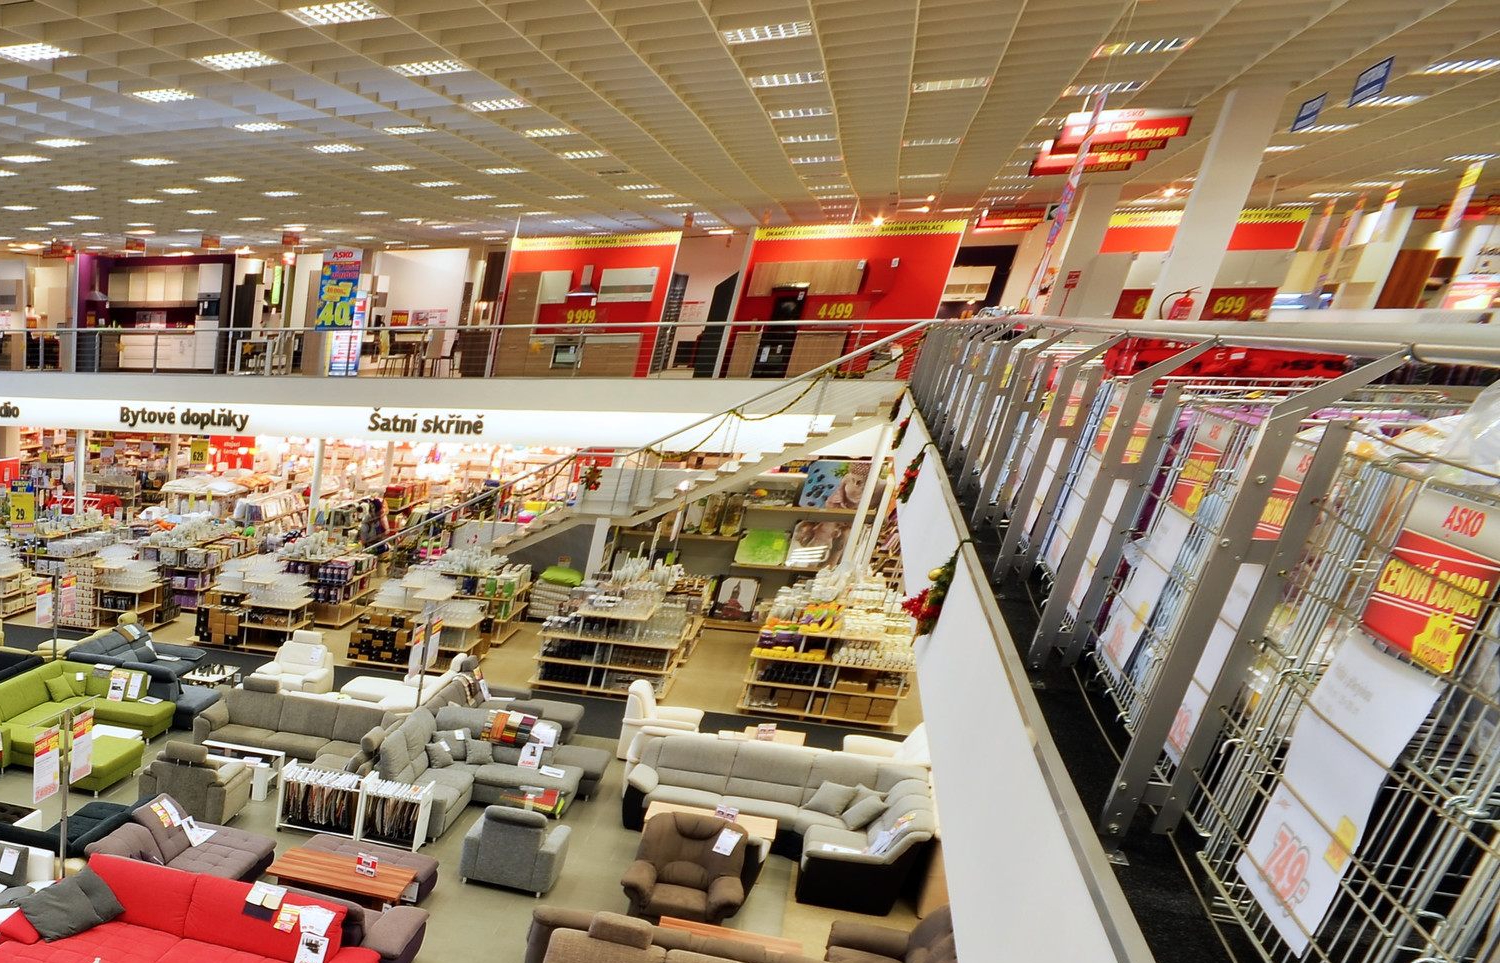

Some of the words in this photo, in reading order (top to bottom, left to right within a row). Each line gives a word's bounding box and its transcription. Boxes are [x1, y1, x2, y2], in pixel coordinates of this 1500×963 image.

[333, 250, 354, 261] ASKO
[1213, 295, 1246, 315] 699
[120, 406, 176, 427] Bytové
[181, 407, 250, 431] doplňky
[367, 408, 417, 433] Šatní
[422, 413, 484, 435] skříně
[192, 450, 204, 461] 629
[1442, 504, 1487, 538] ASKO
[1377, 558, 1440, 606] CENOVÁ
[1429, 569, 1491, 619] BOMBA
